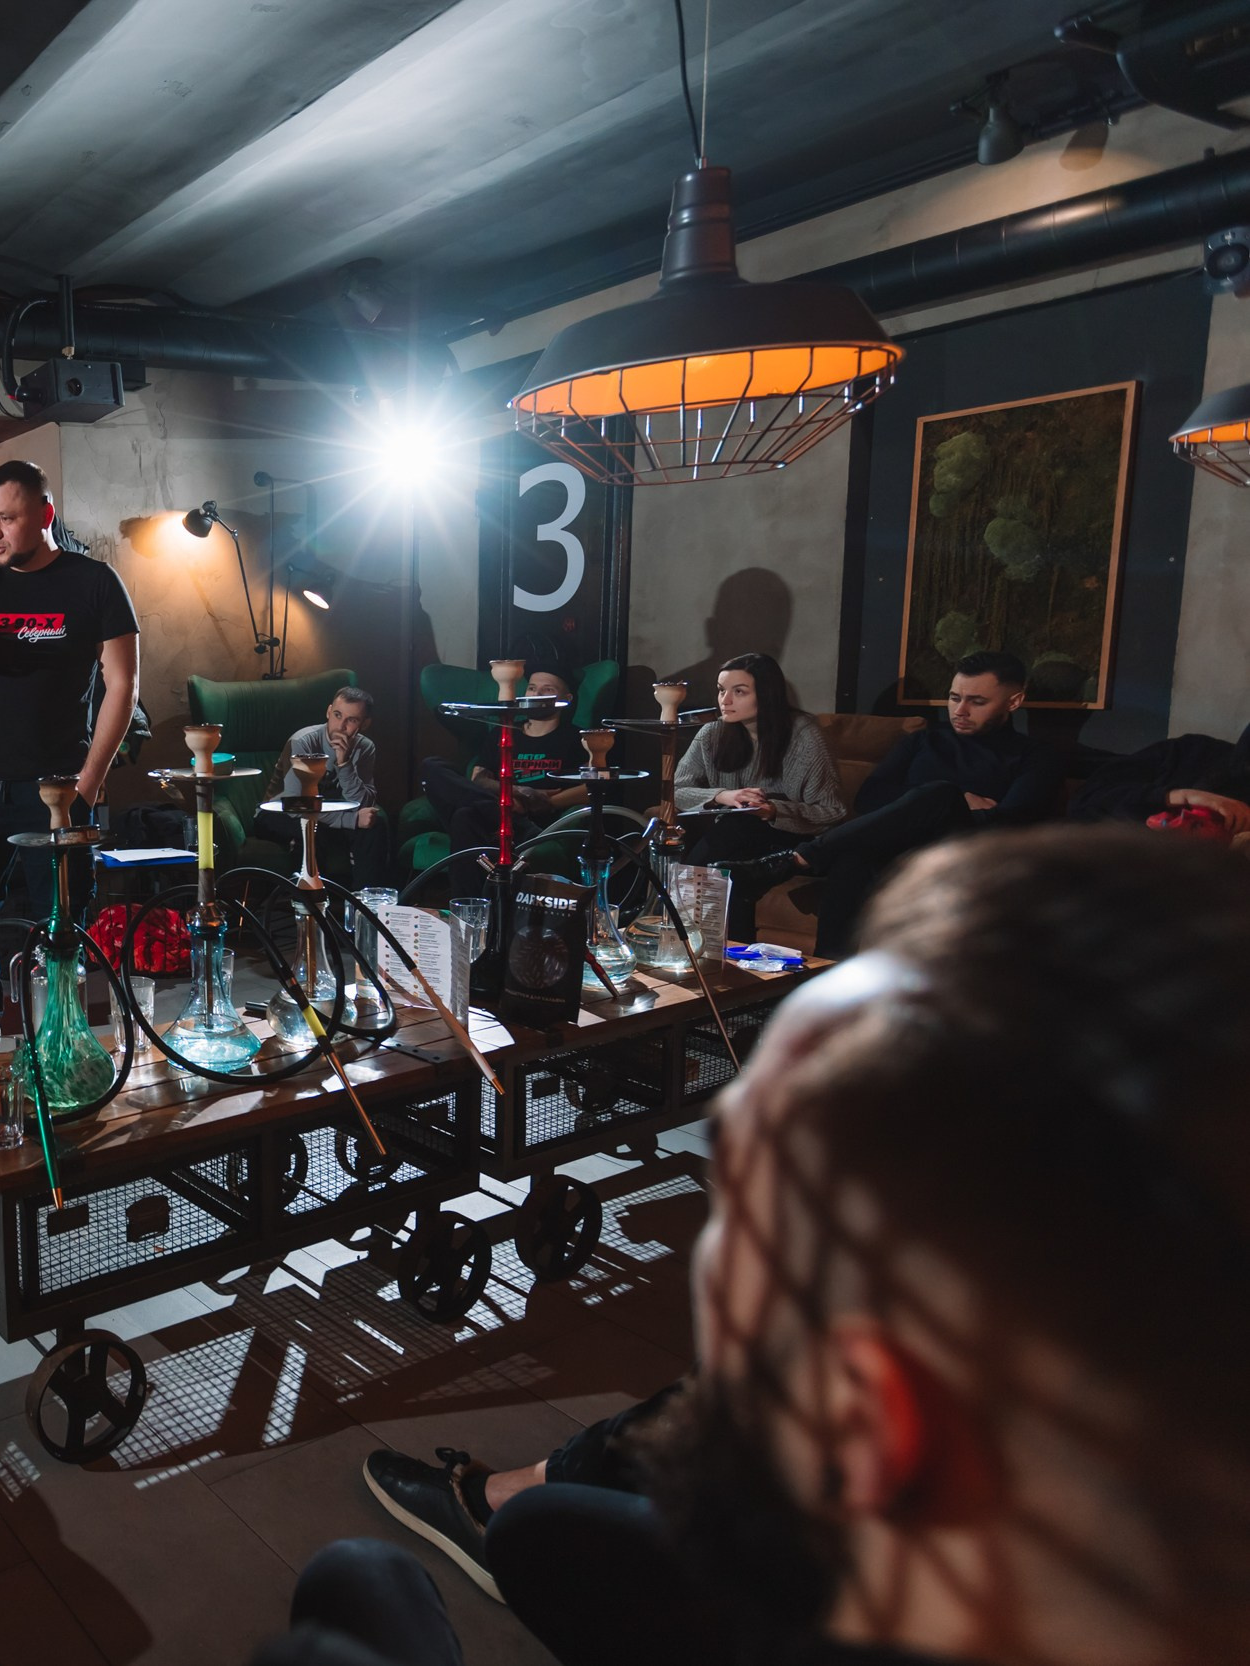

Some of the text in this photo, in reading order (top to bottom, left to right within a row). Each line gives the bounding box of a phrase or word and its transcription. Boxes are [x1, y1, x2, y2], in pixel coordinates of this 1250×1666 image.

[513, 462, 586, 612] 3
[17, 625, 67, 643] Северный
[512, 760, 560, 769] ВЕРНЫЙ
